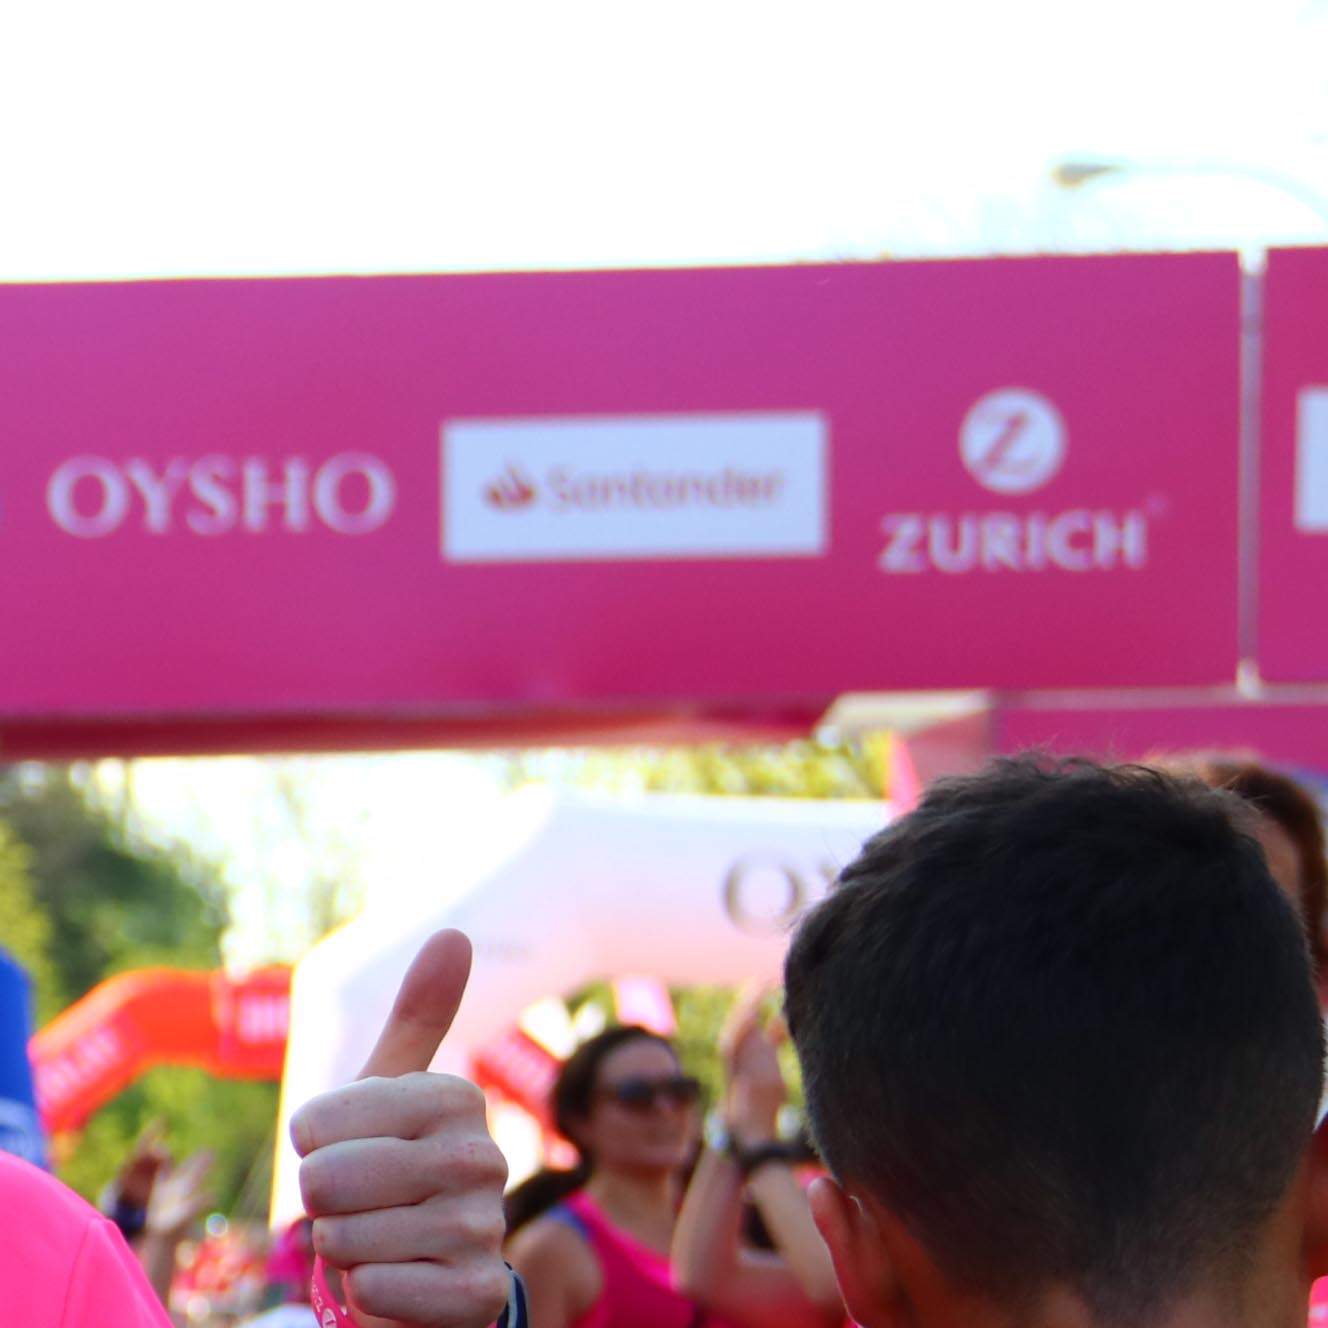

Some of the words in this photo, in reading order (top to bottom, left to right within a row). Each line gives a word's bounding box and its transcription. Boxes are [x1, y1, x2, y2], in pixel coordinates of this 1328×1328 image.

[45, 452, 396, 539] OYSHO
[546, 463, 786, 515] Santander
[877, 508, 1148, 574] ZURICH
